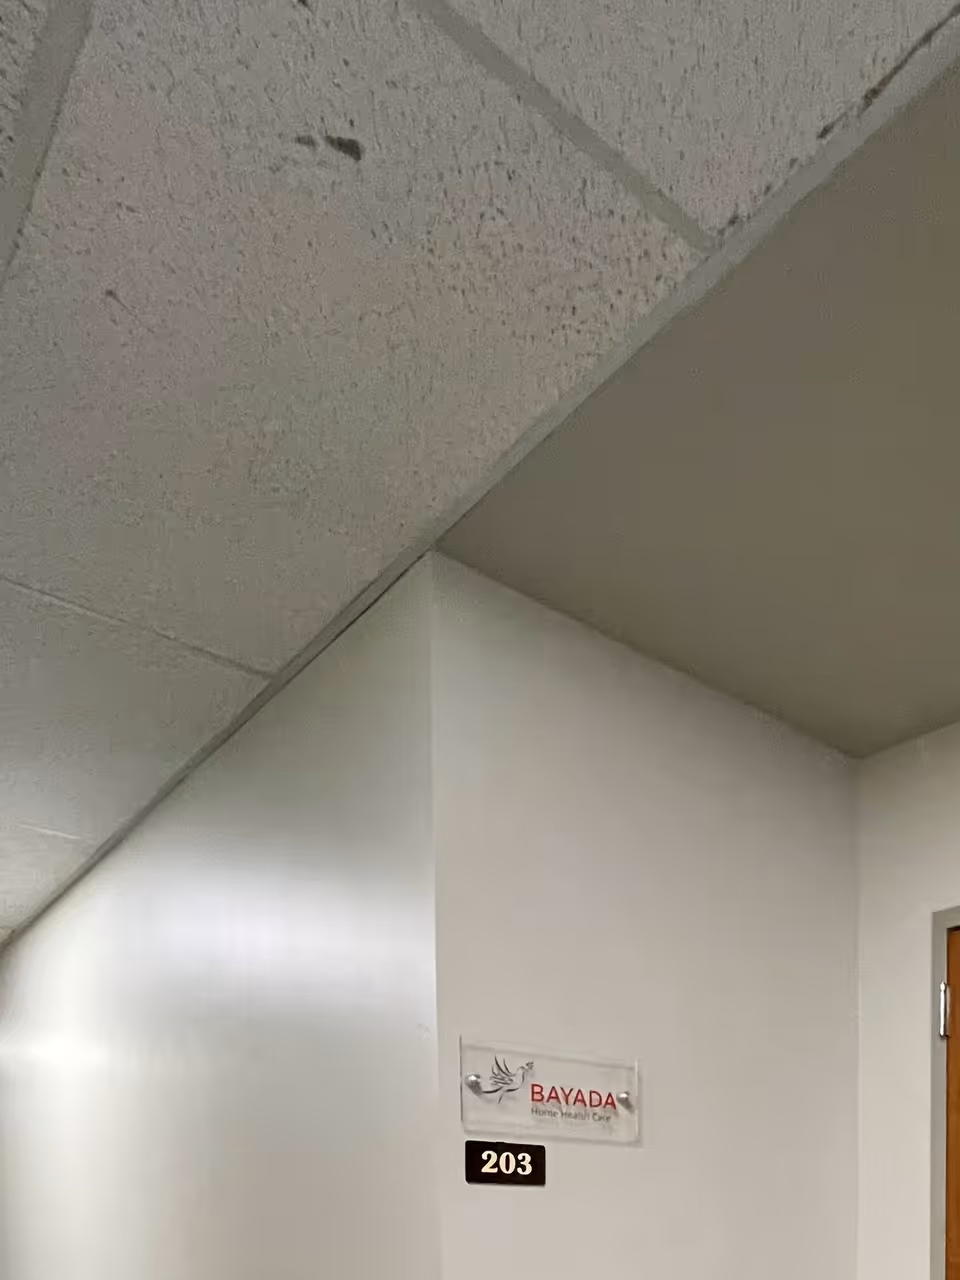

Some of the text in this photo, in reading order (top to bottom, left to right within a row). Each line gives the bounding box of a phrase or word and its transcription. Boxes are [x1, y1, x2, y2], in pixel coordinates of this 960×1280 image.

[531, 1083, 616, 1110] BAYADA
[531, 1107, 558, 1117] Home
[592, 1112, 611, 1122] Care
[481, 1150, 533, 1175] 203
